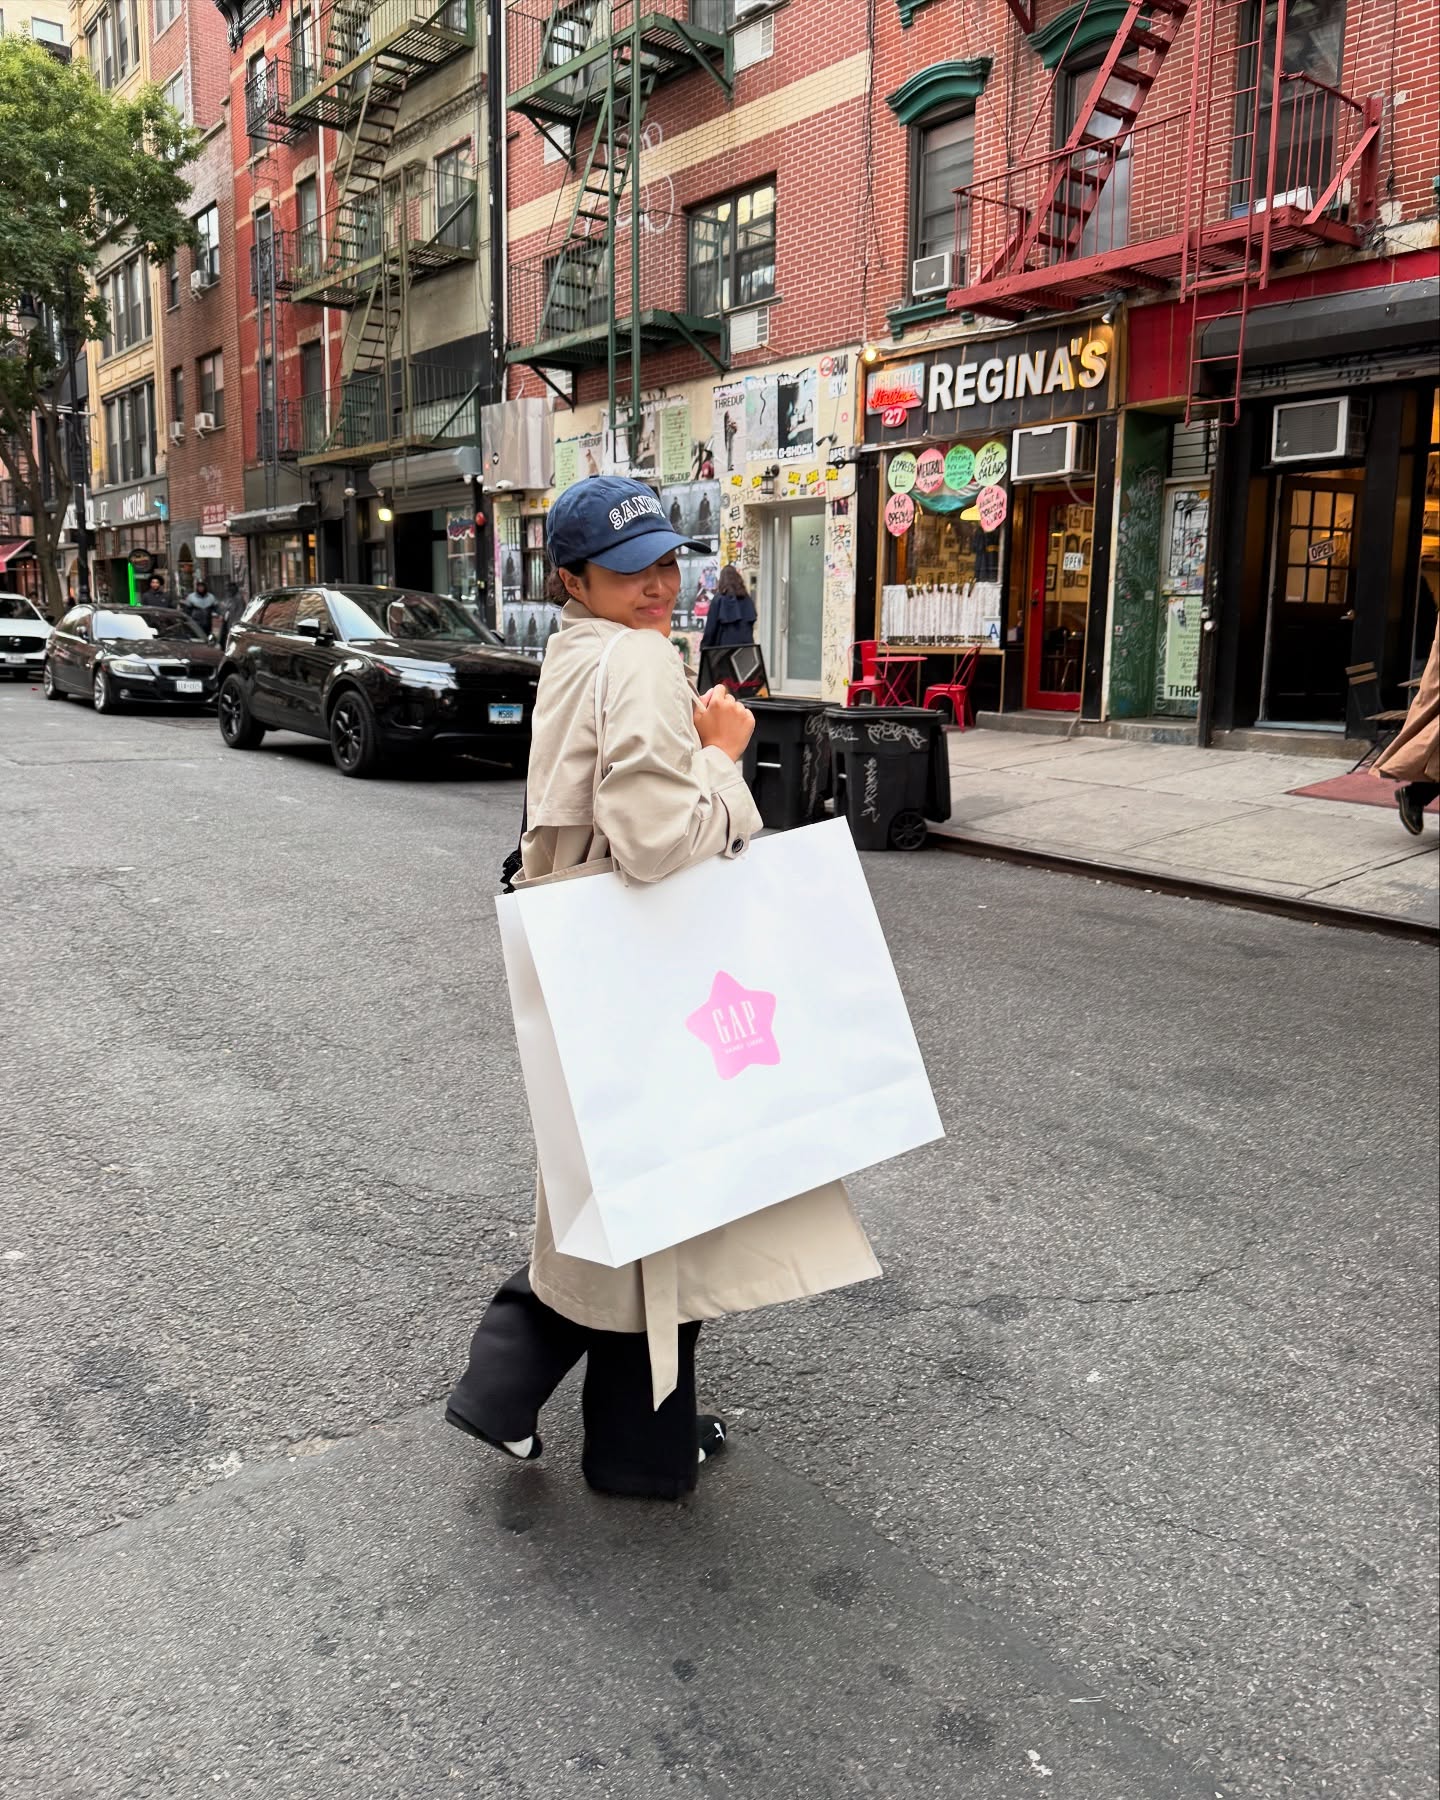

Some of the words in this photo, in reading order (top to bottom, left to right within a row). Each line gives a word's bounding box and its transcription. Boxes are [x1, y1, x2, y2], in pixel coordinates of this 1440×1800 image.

[927, 336, 1109, 413] REGINA'S
[714, 393, 745, 409] THREDUP
[884, 408, 904, 425] 27
[778, 442, 813, 459] G-SHOCK
[916, 459, 945, 478] MEATBALL
[809, 534, 820, 547] 25
[1311, 541, 1335, 560] OPEN
[988, 623, 1000, 639] A
[711, 1000, 757, 1045] GAP
